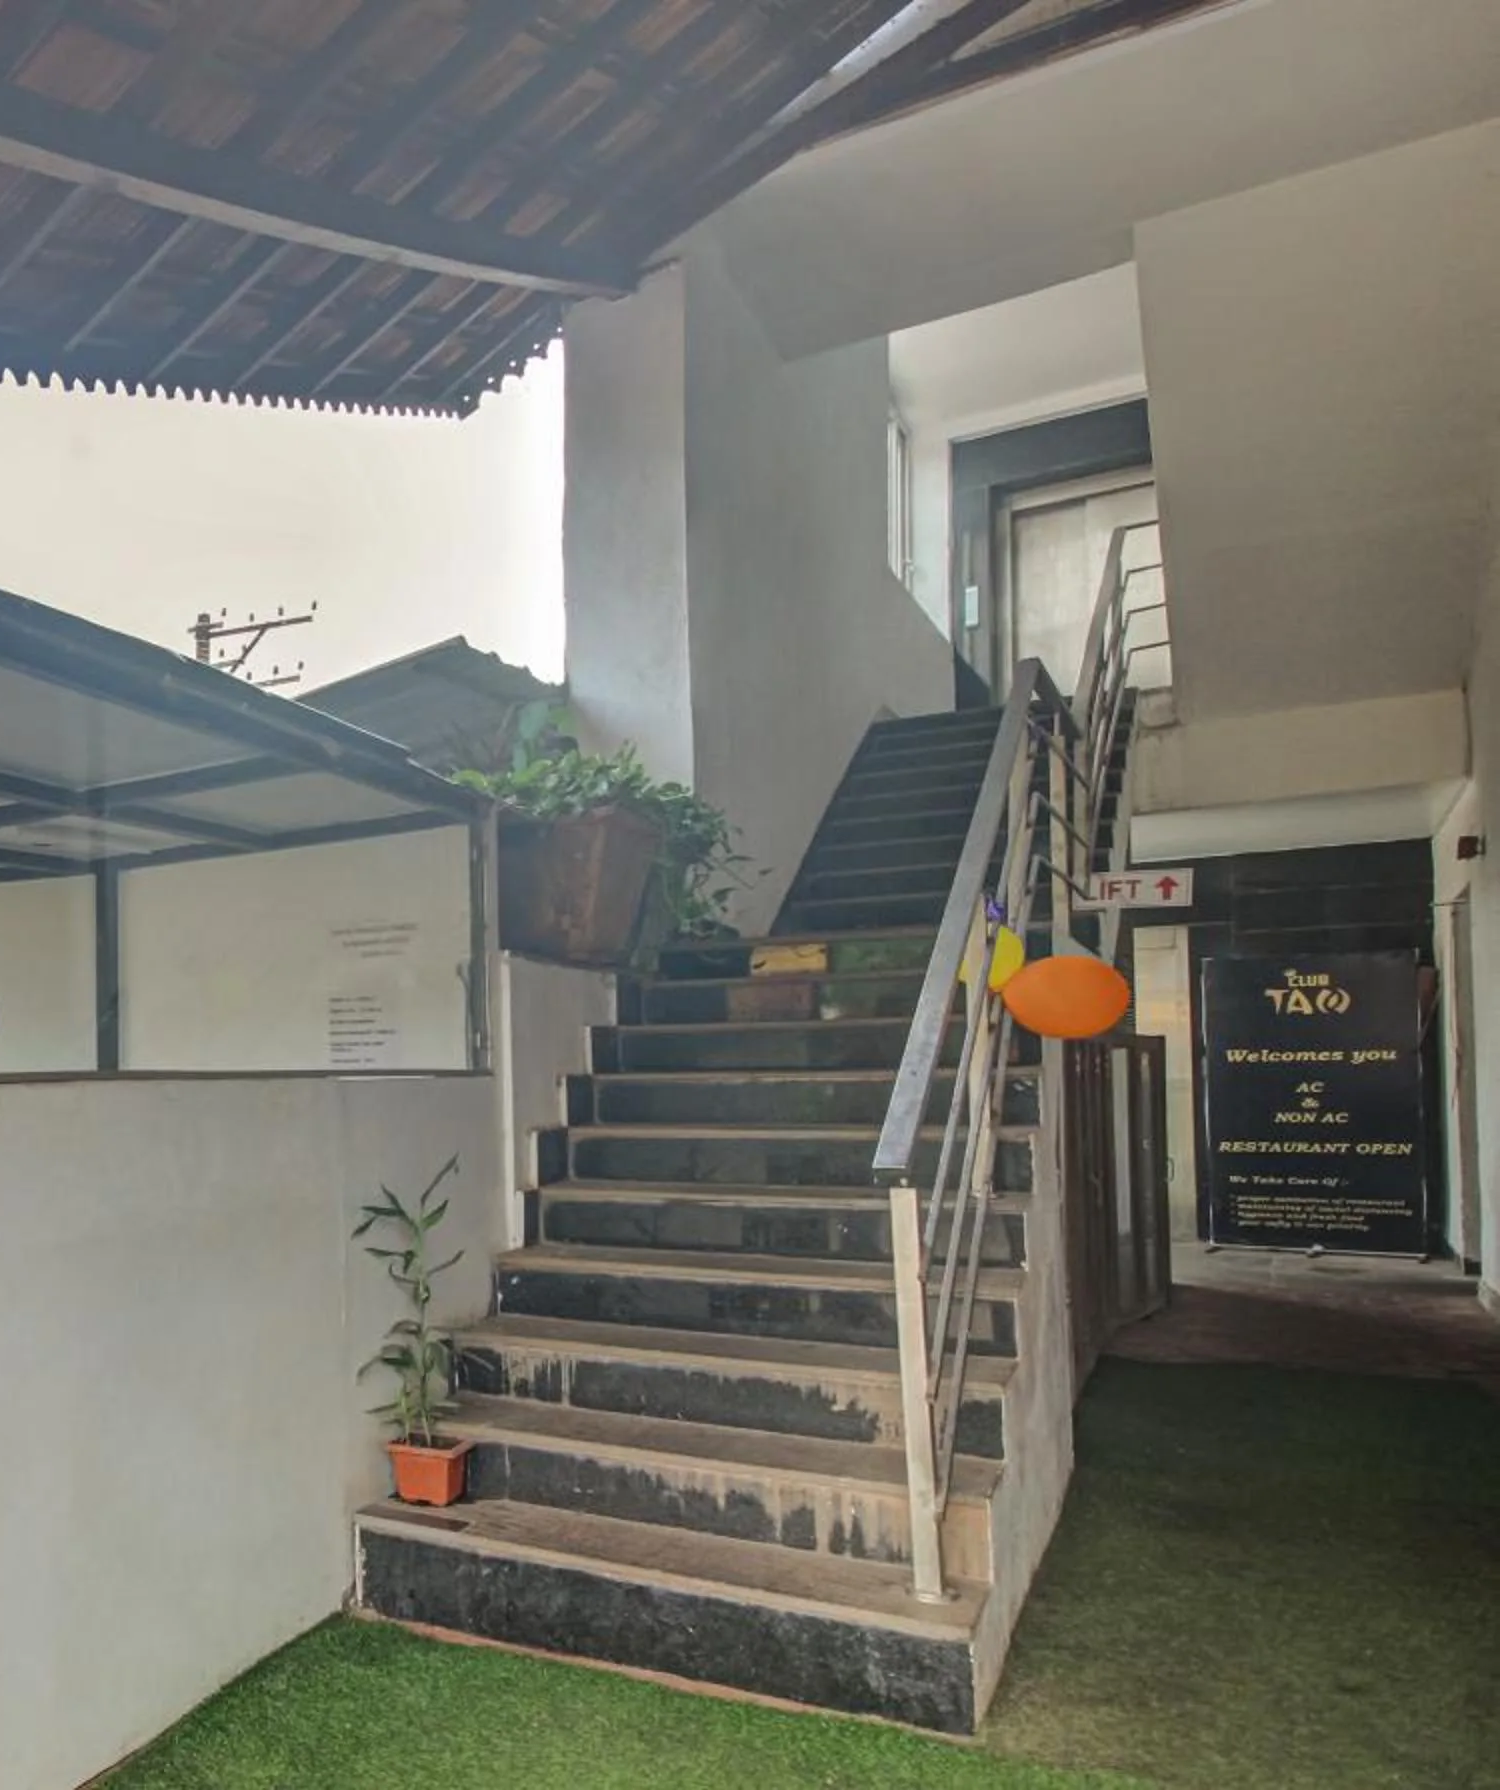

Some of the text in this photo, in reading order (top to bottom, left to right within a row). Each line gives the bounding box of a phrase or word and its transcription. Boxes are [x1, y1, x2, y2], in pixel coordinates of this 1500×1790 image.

[1090, 879, 1142, 900] IFT
[1226, 1049, 1397, 1065] Welcomes you
[1295, 1082, 1325, 1093] AC
[1274, 1112, 1349, 1123] NON AC
[1219, 1142, 1412, 1155] RESTAURANT OPEN
